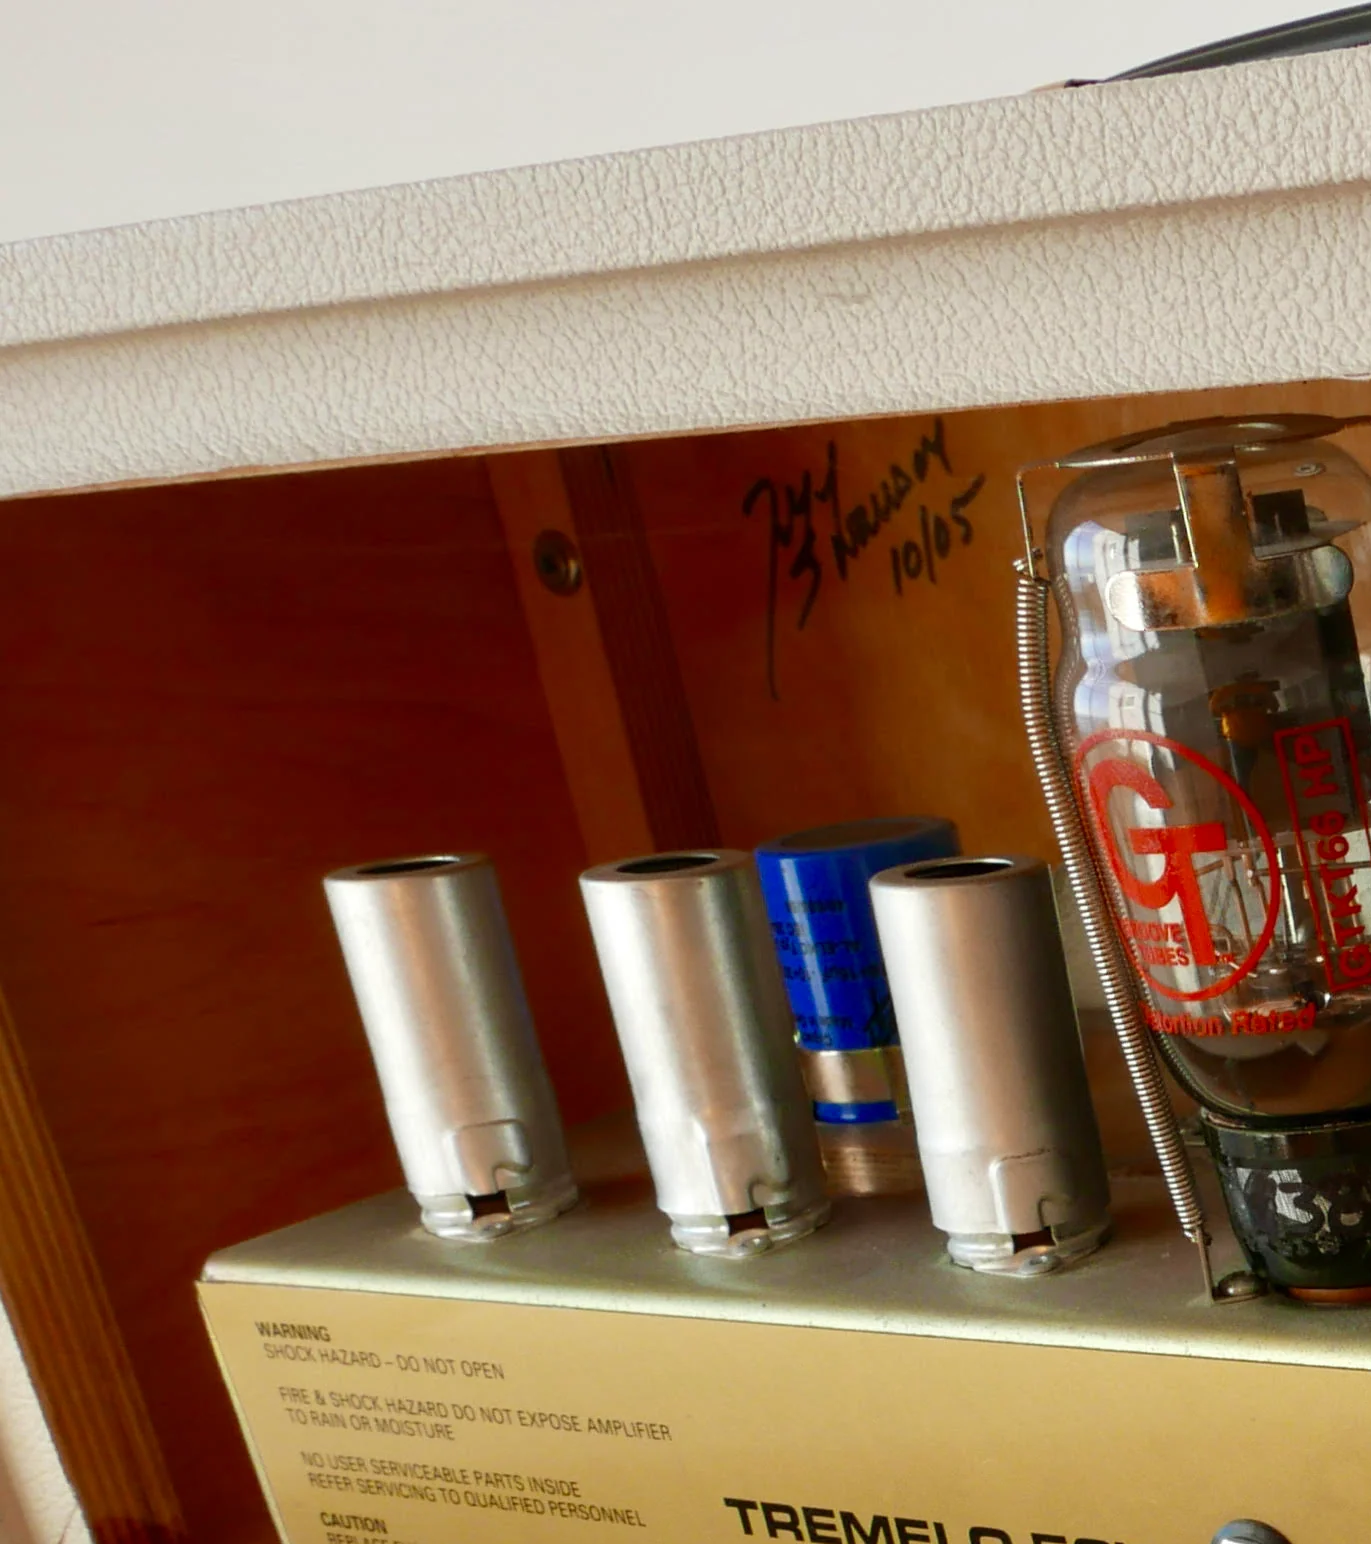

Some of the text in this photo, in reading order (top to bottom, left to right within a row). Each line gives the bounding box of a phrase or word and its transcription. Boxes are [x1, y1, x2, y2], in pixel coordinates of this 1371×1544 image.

[1294, 734, 1336, 800] HP
[1232, 1002, 1316, 1035] Rated
[255, 1321, 331, 1342] WARNING
[263, 1343, 314, 1362] SHOCK
[320, 1350, 380, 1369] HAZARD
[396, 1355, 420, 1373] DO
[424, 1357, 456, 1377] NOT
[463, 1361, 505, 1380] OPEN
[278, 1386, 673, 1442] FIRE & SHOCK HAZARD DO NOT EXPOSE AMPLIFIER
[286, 1408, 456, 1441] TO RAIN OR MOISTURE
[300, 1451, 581, 1498] NO USER SERVICEABLE PARTS INSIDE
[308, 1473, 647, 1528] REFER SERVICING TO QUALIFIED PERSONNEL
[320, 1512, 388, 1535] CAUTION
